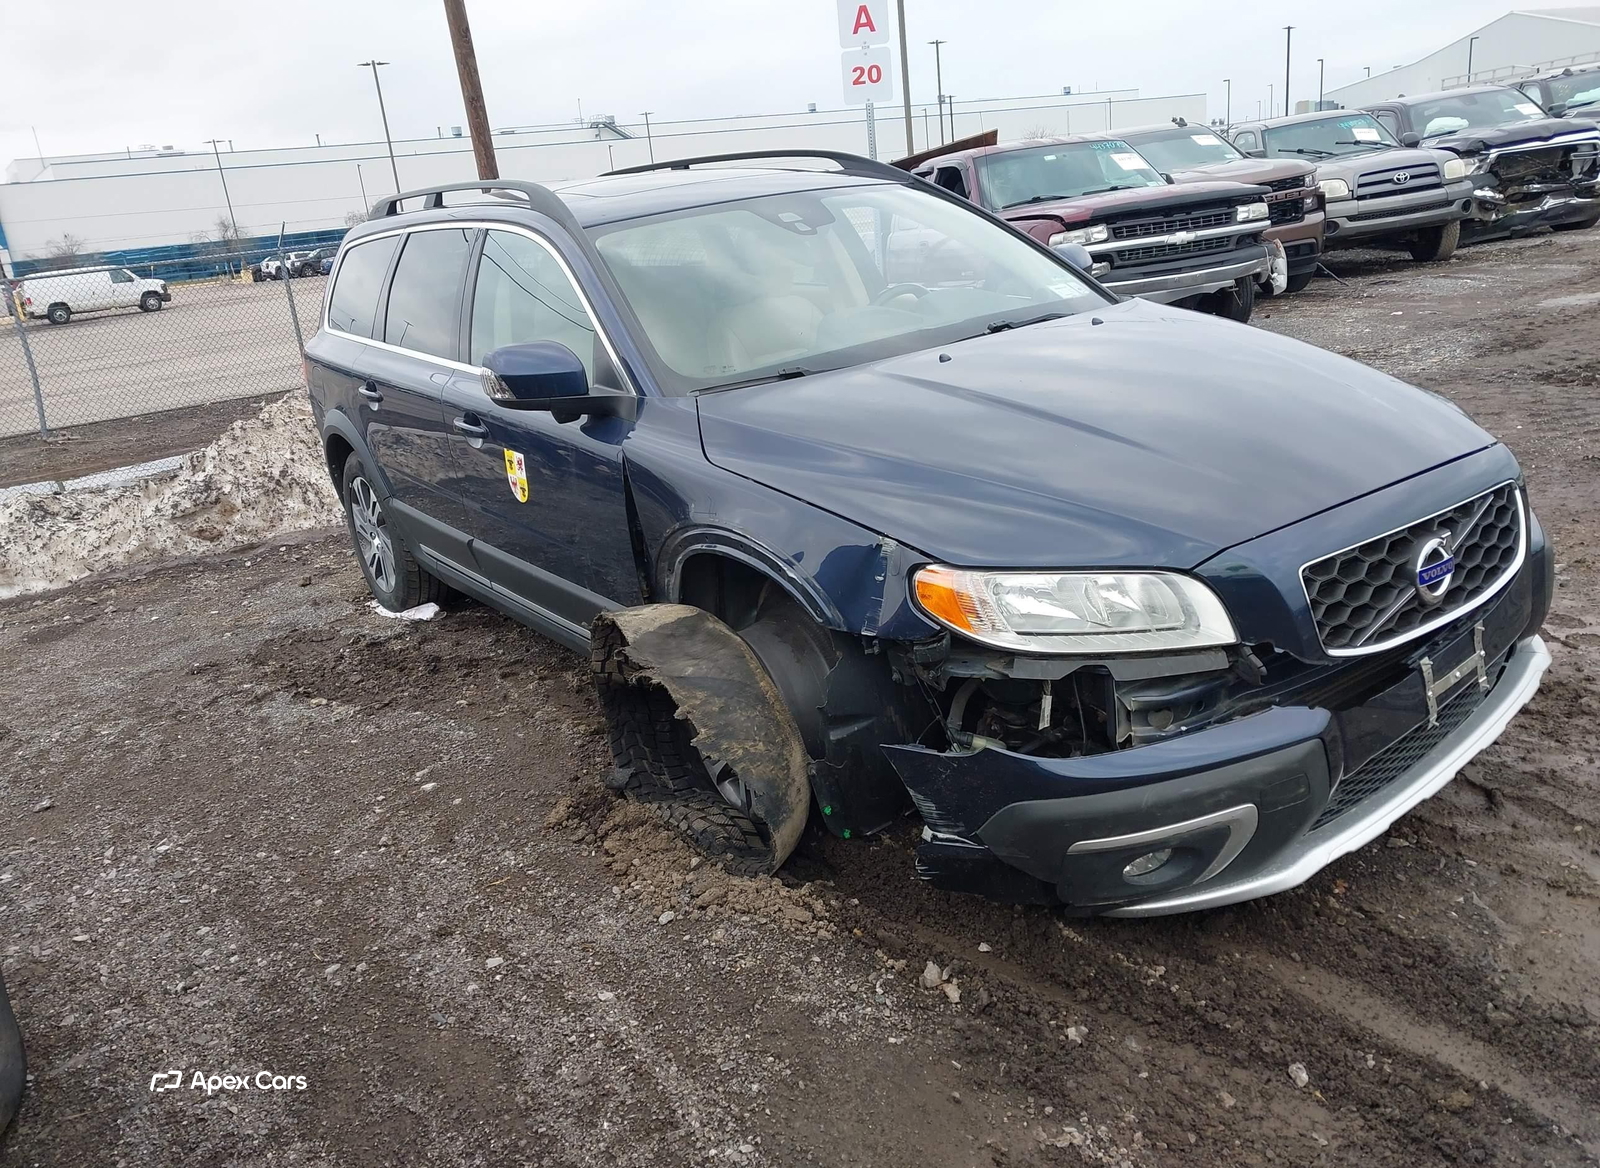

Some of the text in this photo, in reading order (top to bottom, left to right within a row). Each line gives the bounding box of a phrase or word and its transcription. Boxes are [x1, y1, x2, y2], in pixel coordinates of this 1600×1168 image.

[852, 4, 876, 35] A
[852, 64, 882, 86] 20
[1422, 561, 1453, 581] VOLVO
